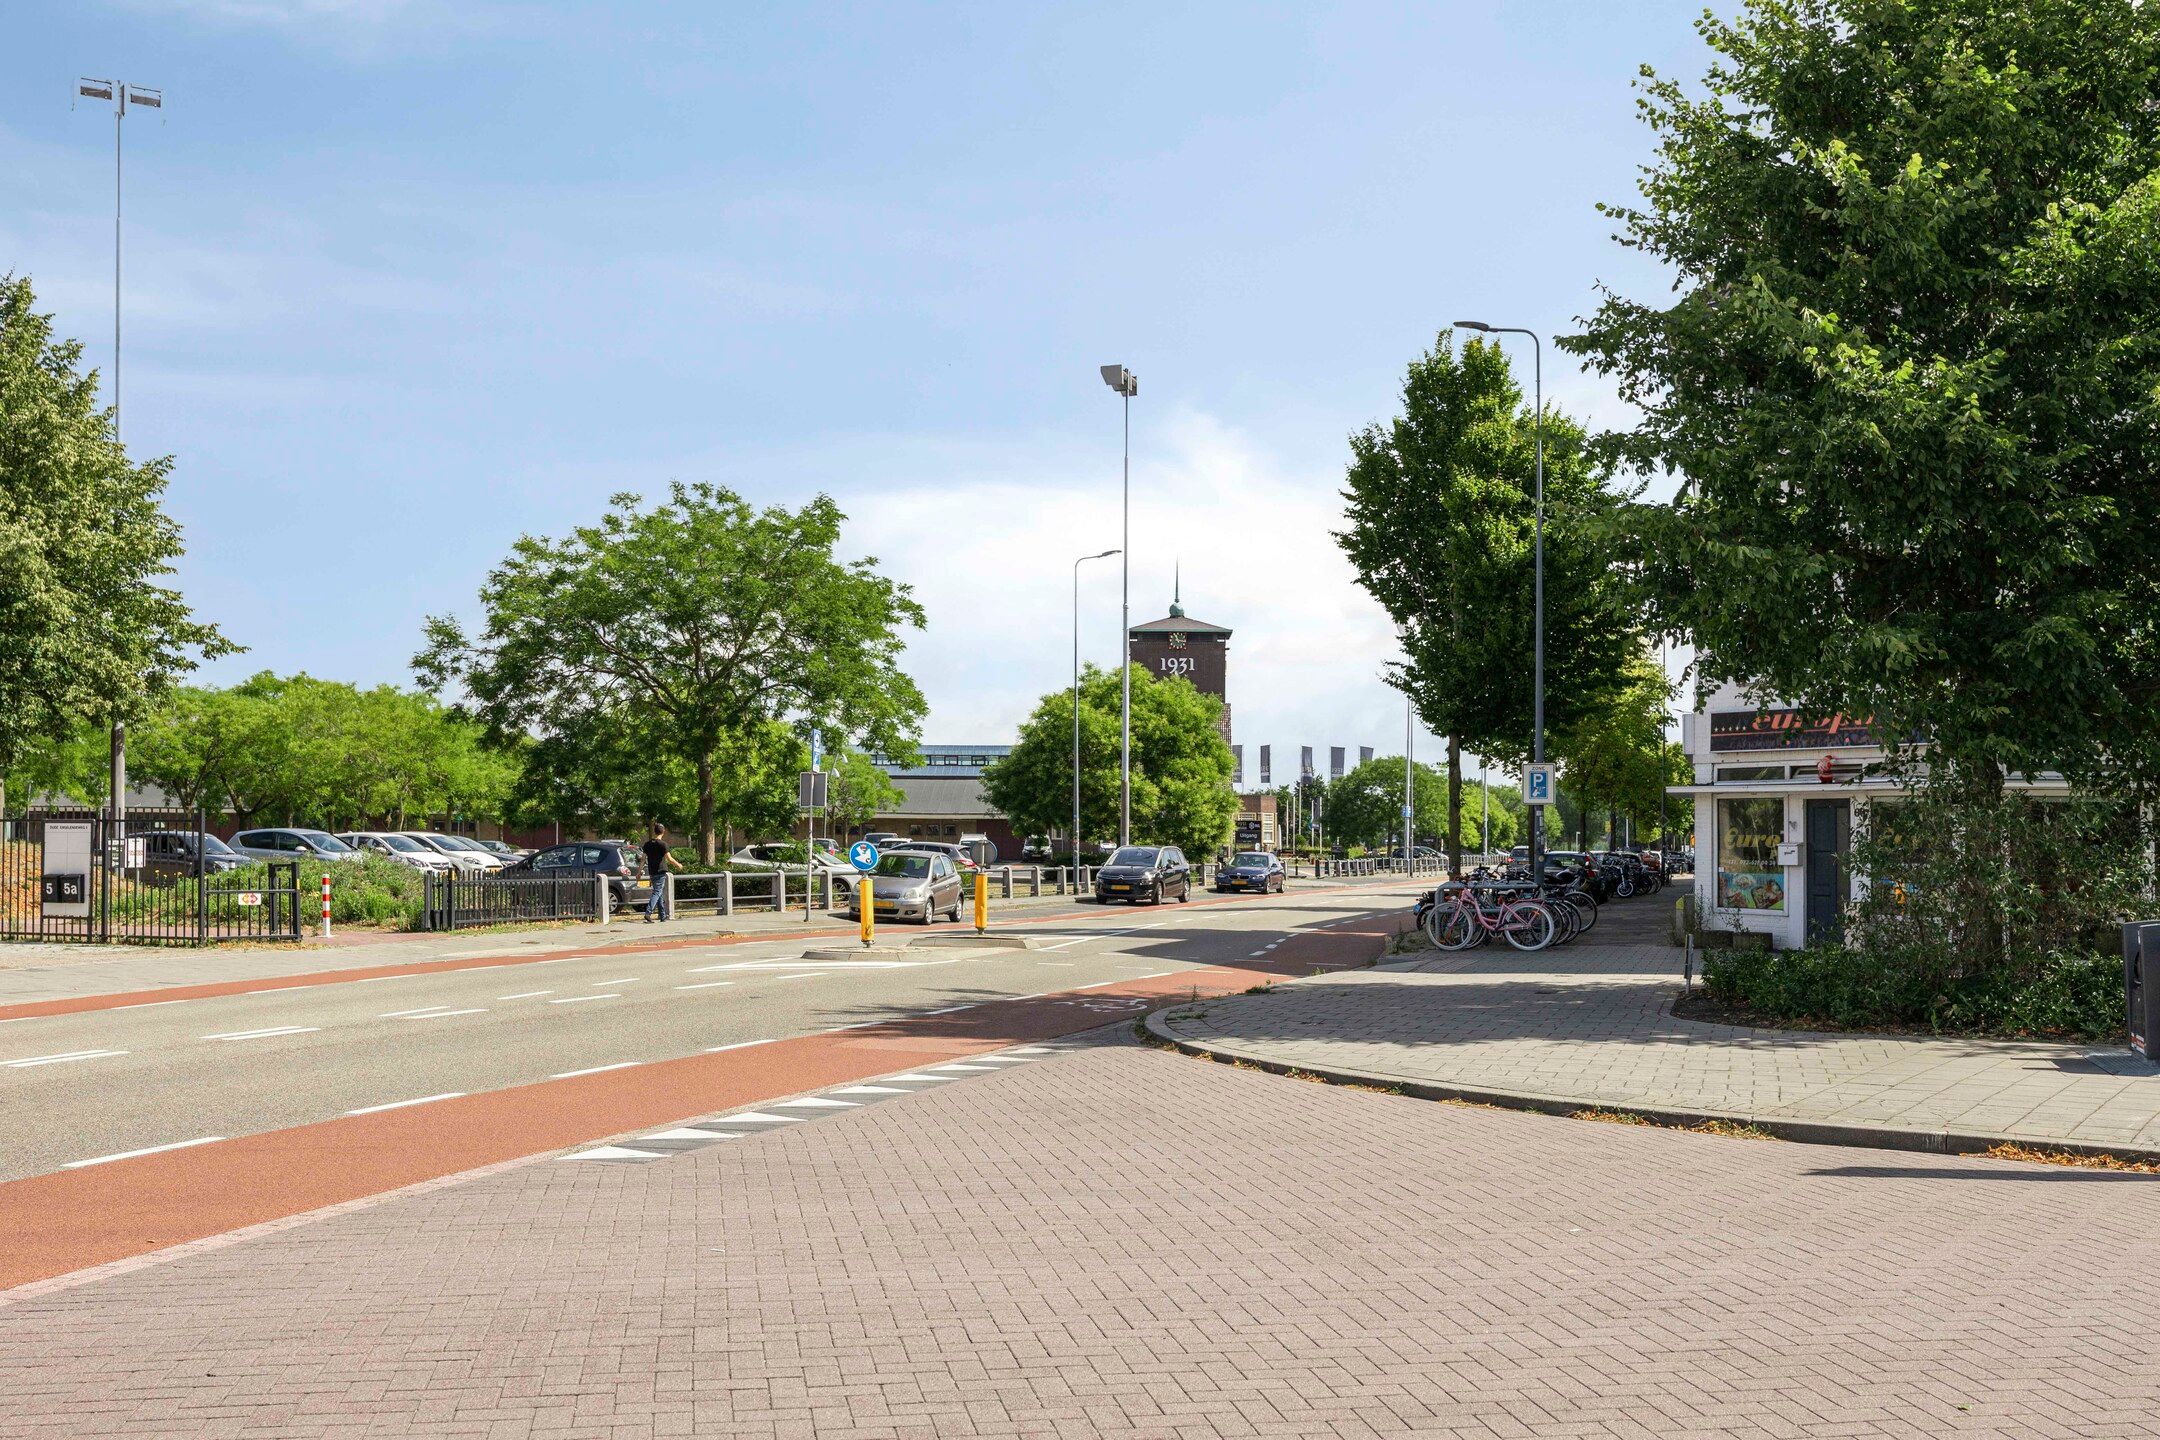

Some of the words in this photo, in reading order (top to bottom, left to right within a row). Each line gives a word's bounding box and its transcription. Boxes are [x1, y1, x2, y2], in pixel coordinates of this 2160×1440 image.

[1160, 657, 1195, 675] 1931
[1534, 773, 1543, 787] P
[46, 883, 53, 894] 5
[64, 883, 77, 894] 5a
